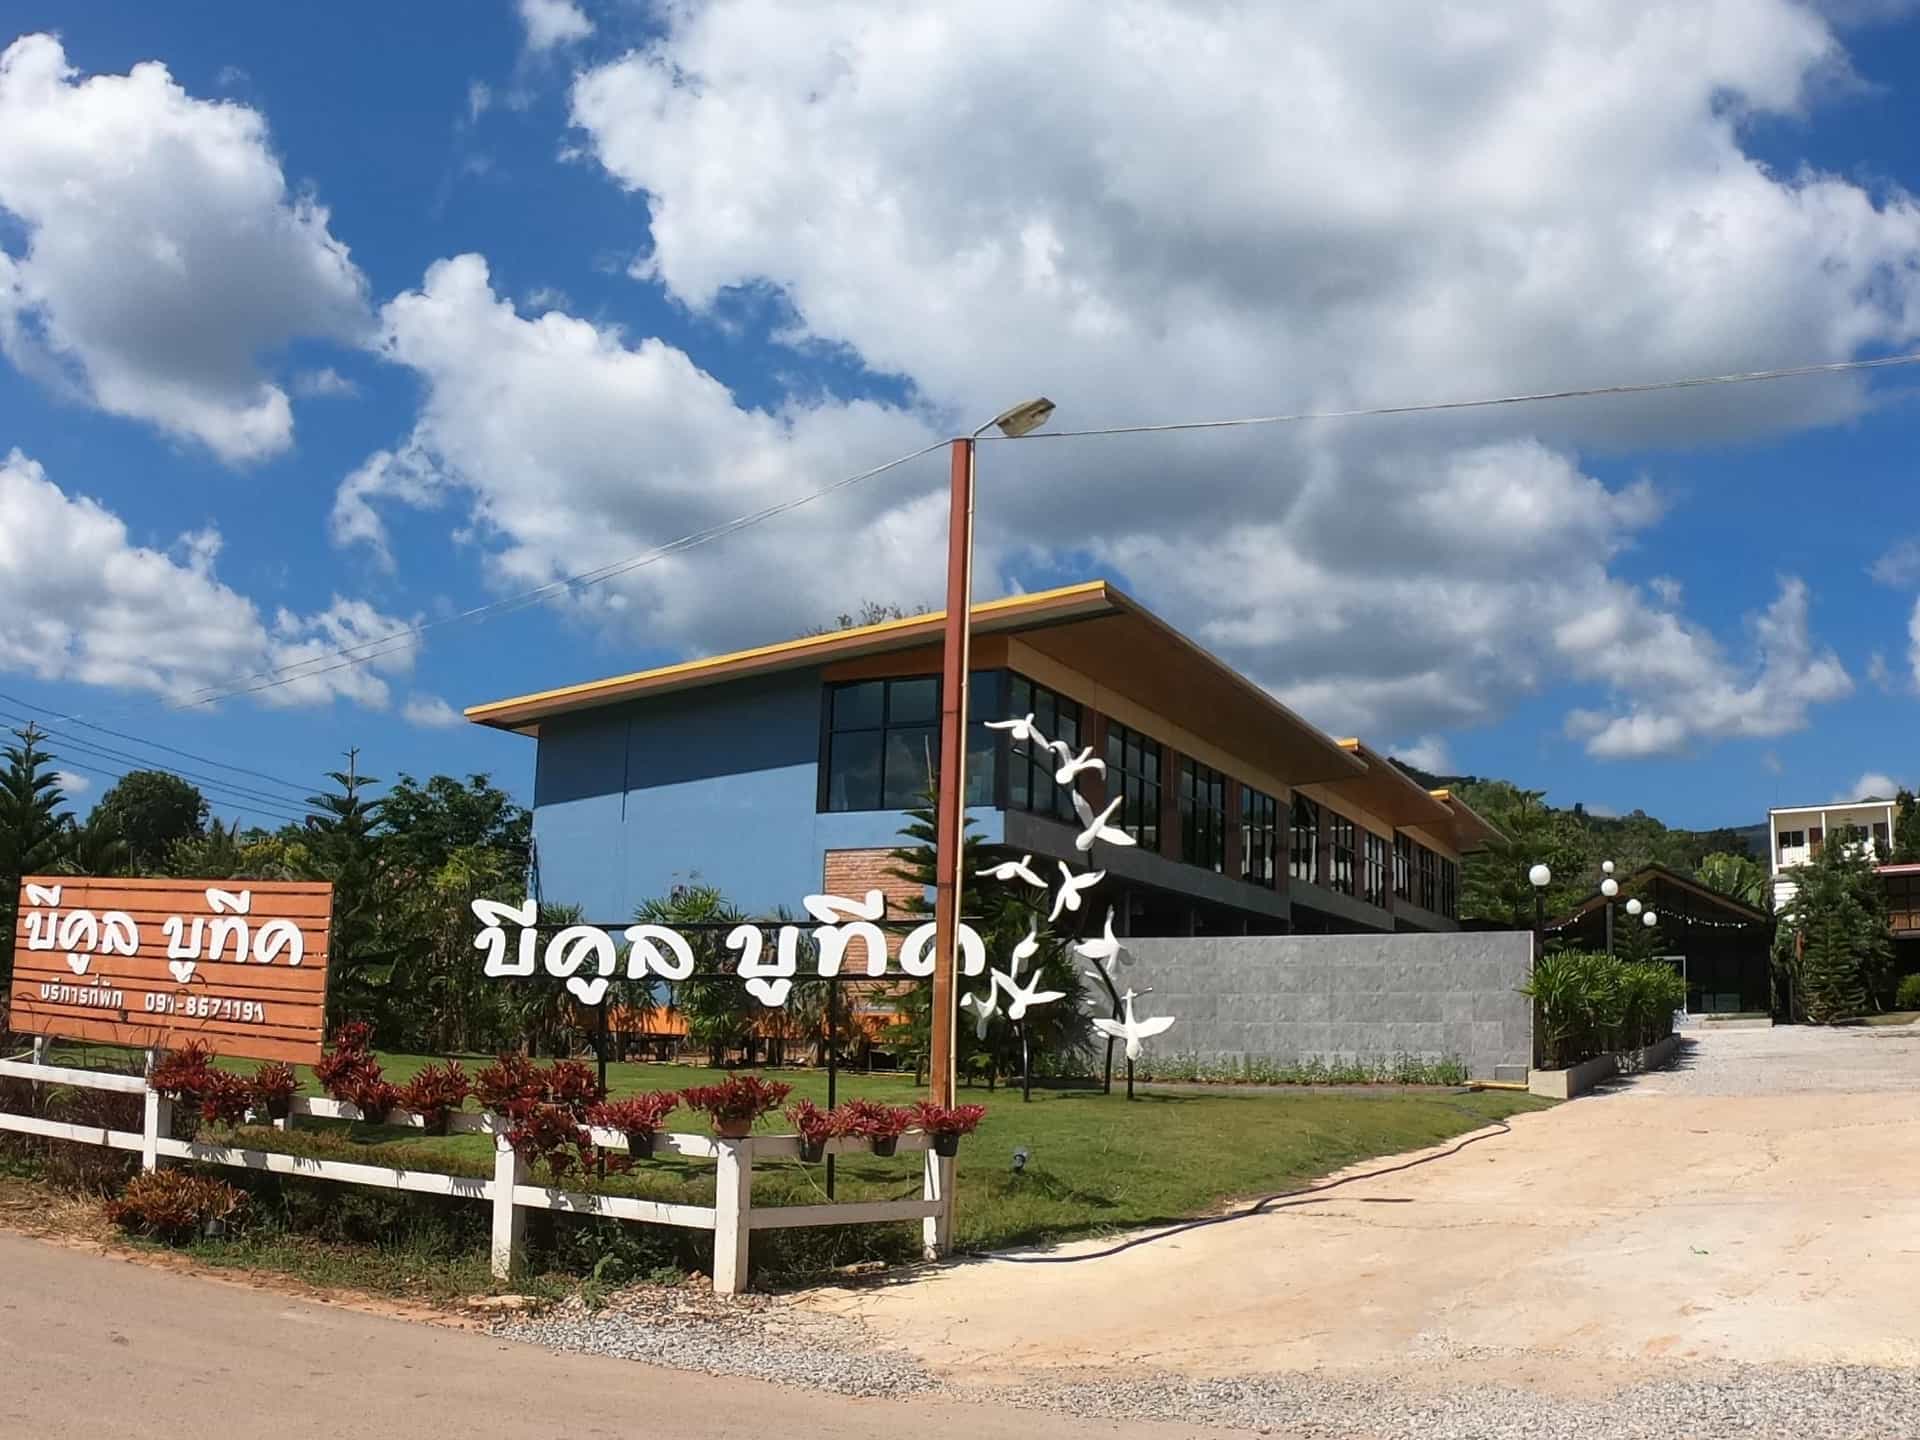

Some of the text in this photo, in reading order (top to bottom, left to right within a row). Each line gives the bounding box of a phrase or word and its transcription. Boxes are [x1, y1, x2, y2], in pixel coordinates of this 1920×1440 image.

[25, 883, 304, 984] บีคูล บูทีค
[471, 889, 986, 1007] บีคูล บูทีค
